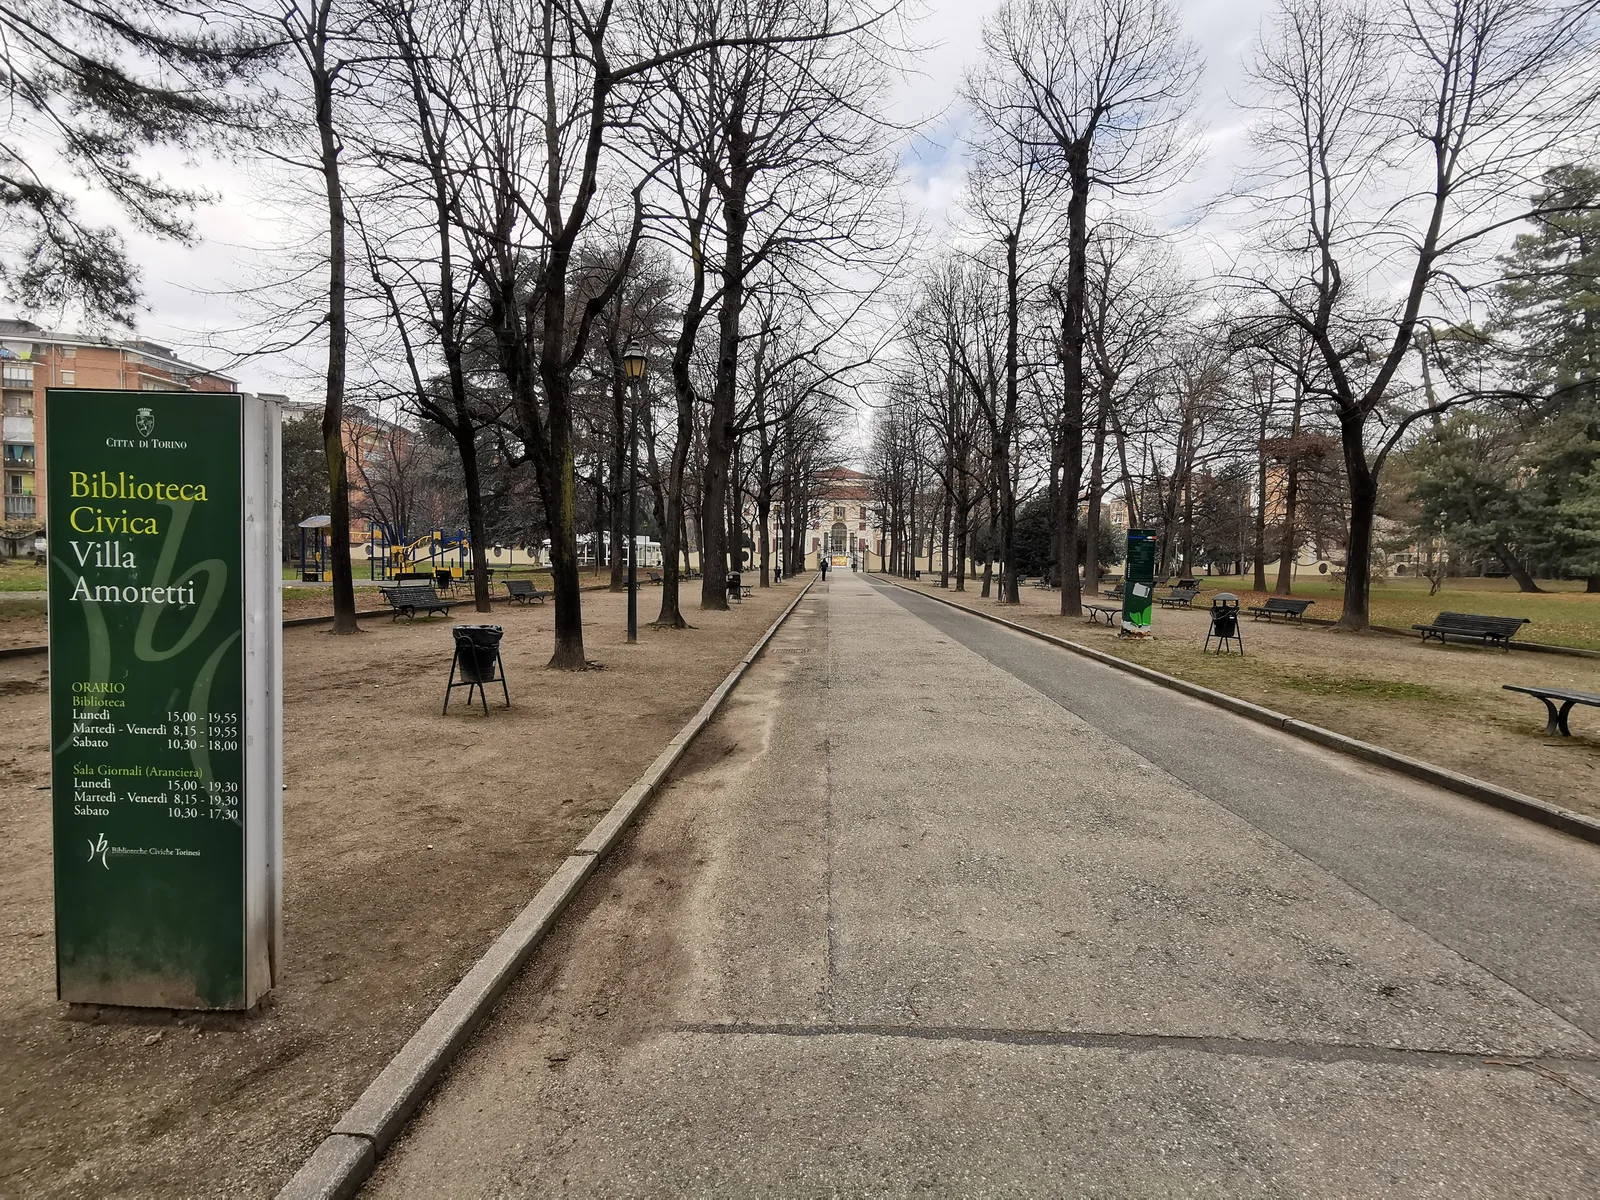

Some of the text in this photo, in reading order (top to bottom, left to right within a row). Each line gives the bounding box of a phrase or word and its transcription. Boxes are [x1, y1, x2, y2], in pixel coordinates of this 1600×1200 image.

[151, 439, 187, 449] TORINO
[69, 471, 208, 501] Biblioteca
[70, 506, 159, 534] Civica
[69, 540, 137, 568] Villa
[69, 575, 196, 605] Amoretti
[72, 682, 125, 693] ORARIO
[73, 696, 125, 707] Biblioteca
[73, 709, 110, 720] Lunedì
[167, 712, 196, 723] 15,00
[208, 713, 237, 724] 19,55
[73, 722, 115, 734] Martedì
[127, 724, 167, 734] Venerdì
[173, 726, 196, 736] 8,15
[208, 726, 237, 738] 19,55
[73, 736, 108, 747] Sabato
[168, 739, 196, 750] 10,30
[209, 741, 237, 751] 18,00
[73, 764, 203, 779] Sala Giornali (Aranciera)
[74, 778, 111, 788] Lunedì
[168, 780, 197, 792] 15,00
[209, 782, 238, 793] 19,30
[74, 791, 116, 802] Martedì
[127, 793, 168, 803] Venerdì
[174, 794, 196, 805] 8,15
[209, 795, 238, 806] 19,30
[74, 805, 109, 816] Sabato
[168, 808, 197, 819] 10,30
[209, 809, 238, 820] 17,30
